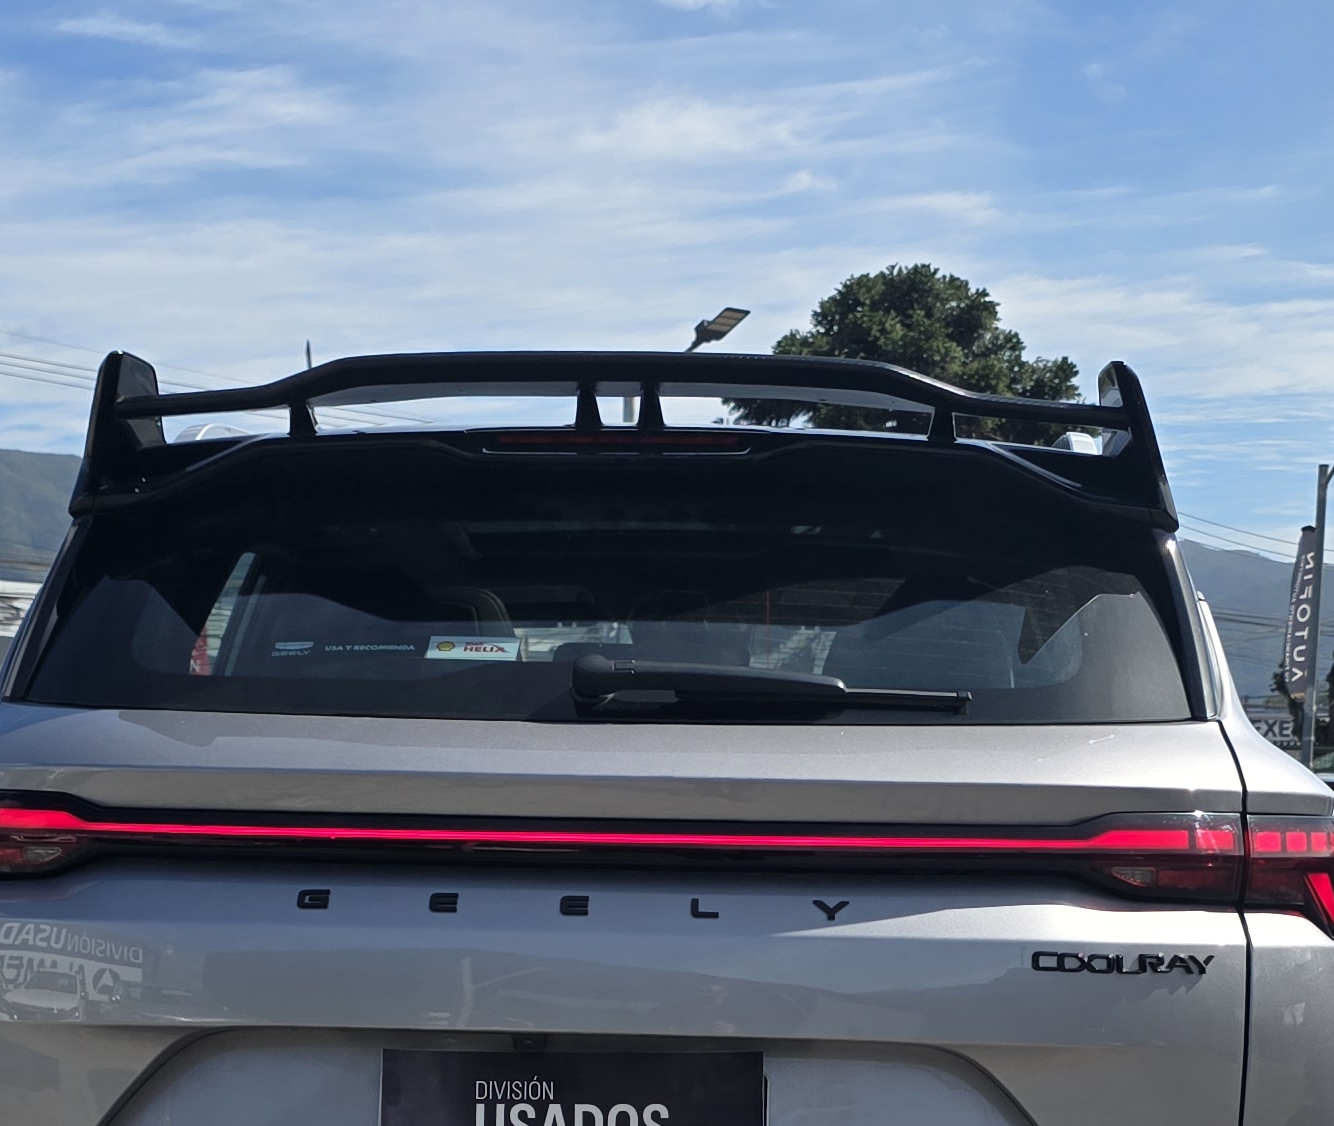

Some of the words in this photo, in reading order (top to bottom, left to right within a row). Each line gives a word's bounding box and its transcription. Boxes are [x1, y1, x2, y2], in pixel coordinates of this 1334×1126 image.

[271, 649, 312, 657] GEELY
[297, 888, 850, 921] GEELY
[1031, 950, 1216, 975] COOLRAY
[475, 1075, 555, 1101] DIVISIÓN
